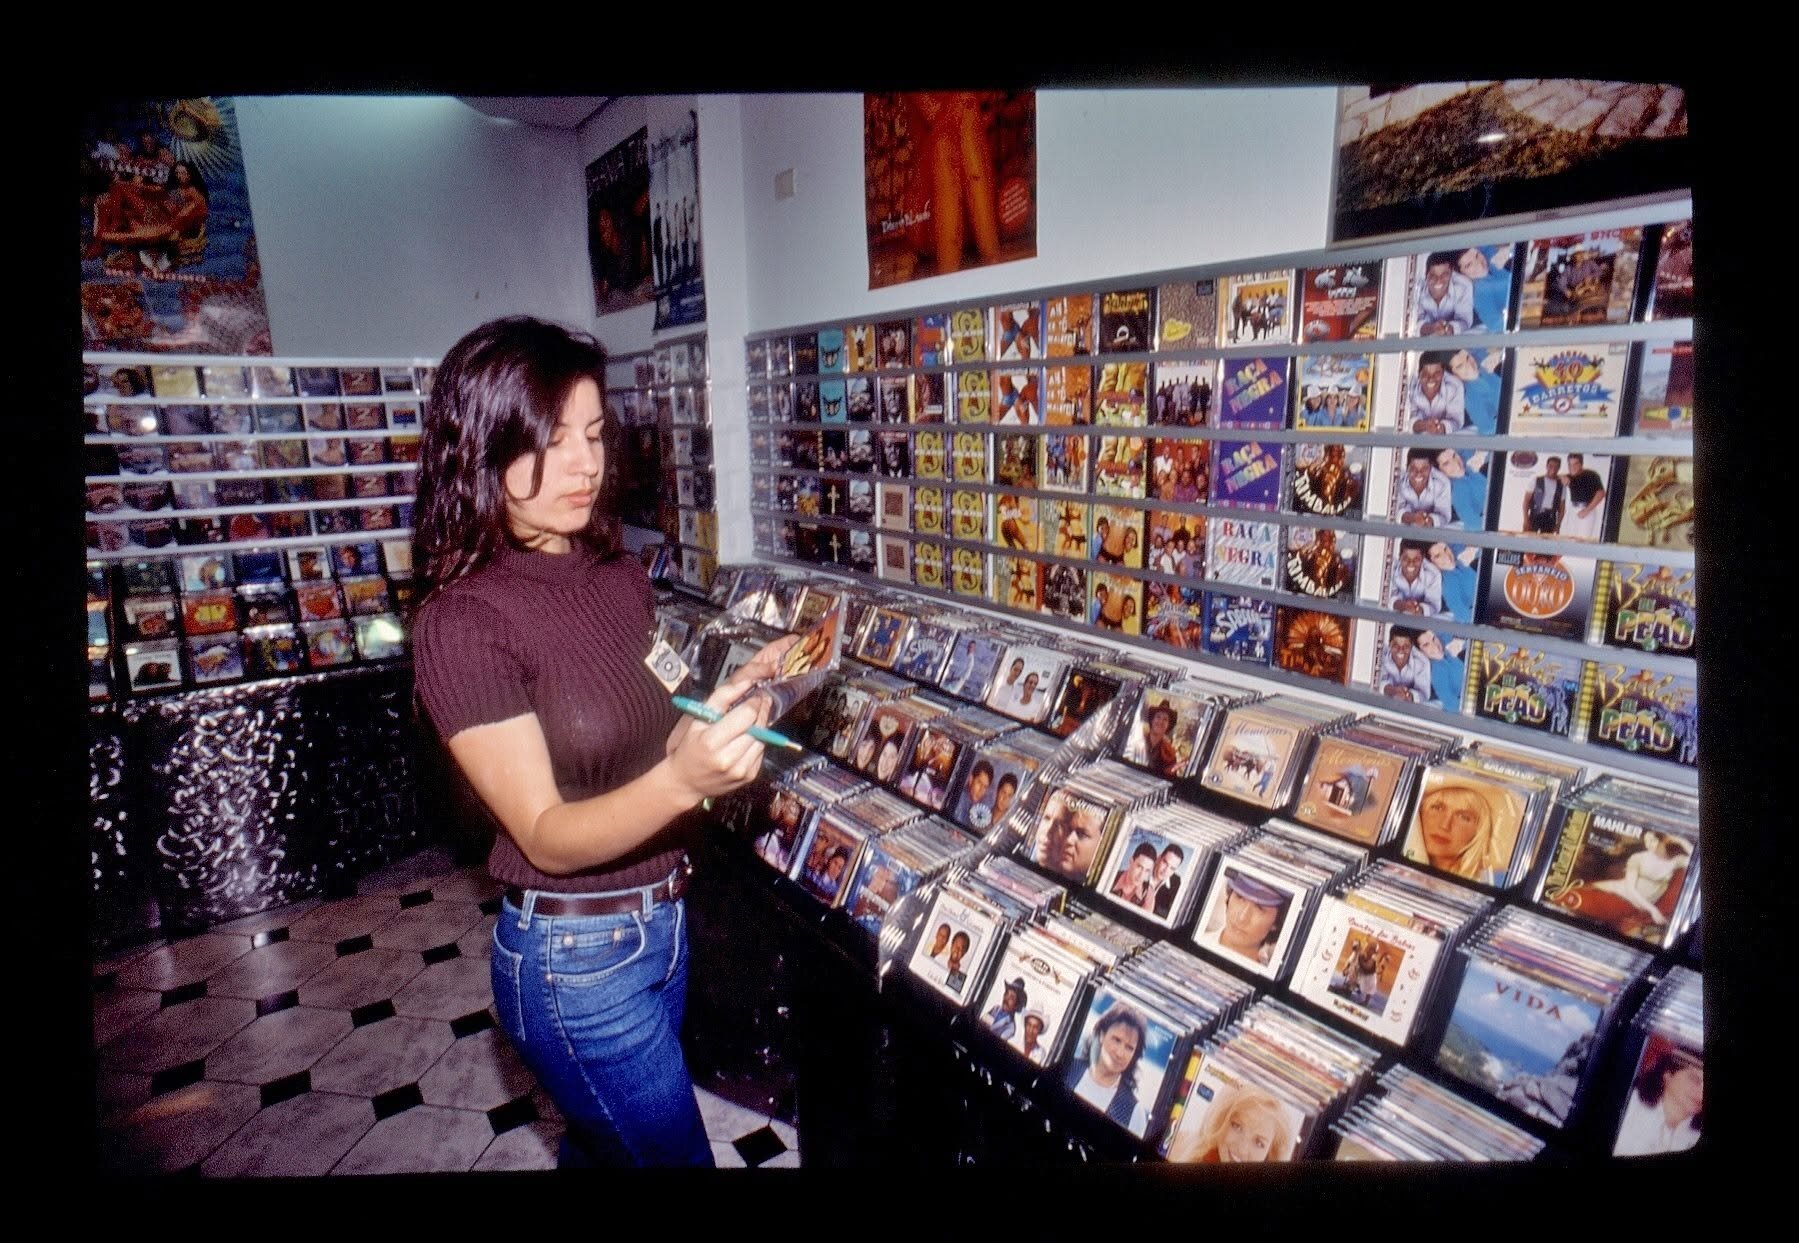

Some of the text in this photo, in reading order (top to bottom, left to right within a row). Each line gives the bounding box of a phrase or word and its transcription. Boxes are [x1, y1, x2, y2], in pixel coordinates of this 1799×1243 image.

[1532, 384, 1603, 404] BARRETOS
[1515, 564, 1569, 581] SERTANEJO
[1593, 815, 1643, 840] MAHLER
[1494, 979, 1562, 1021] VIDA
